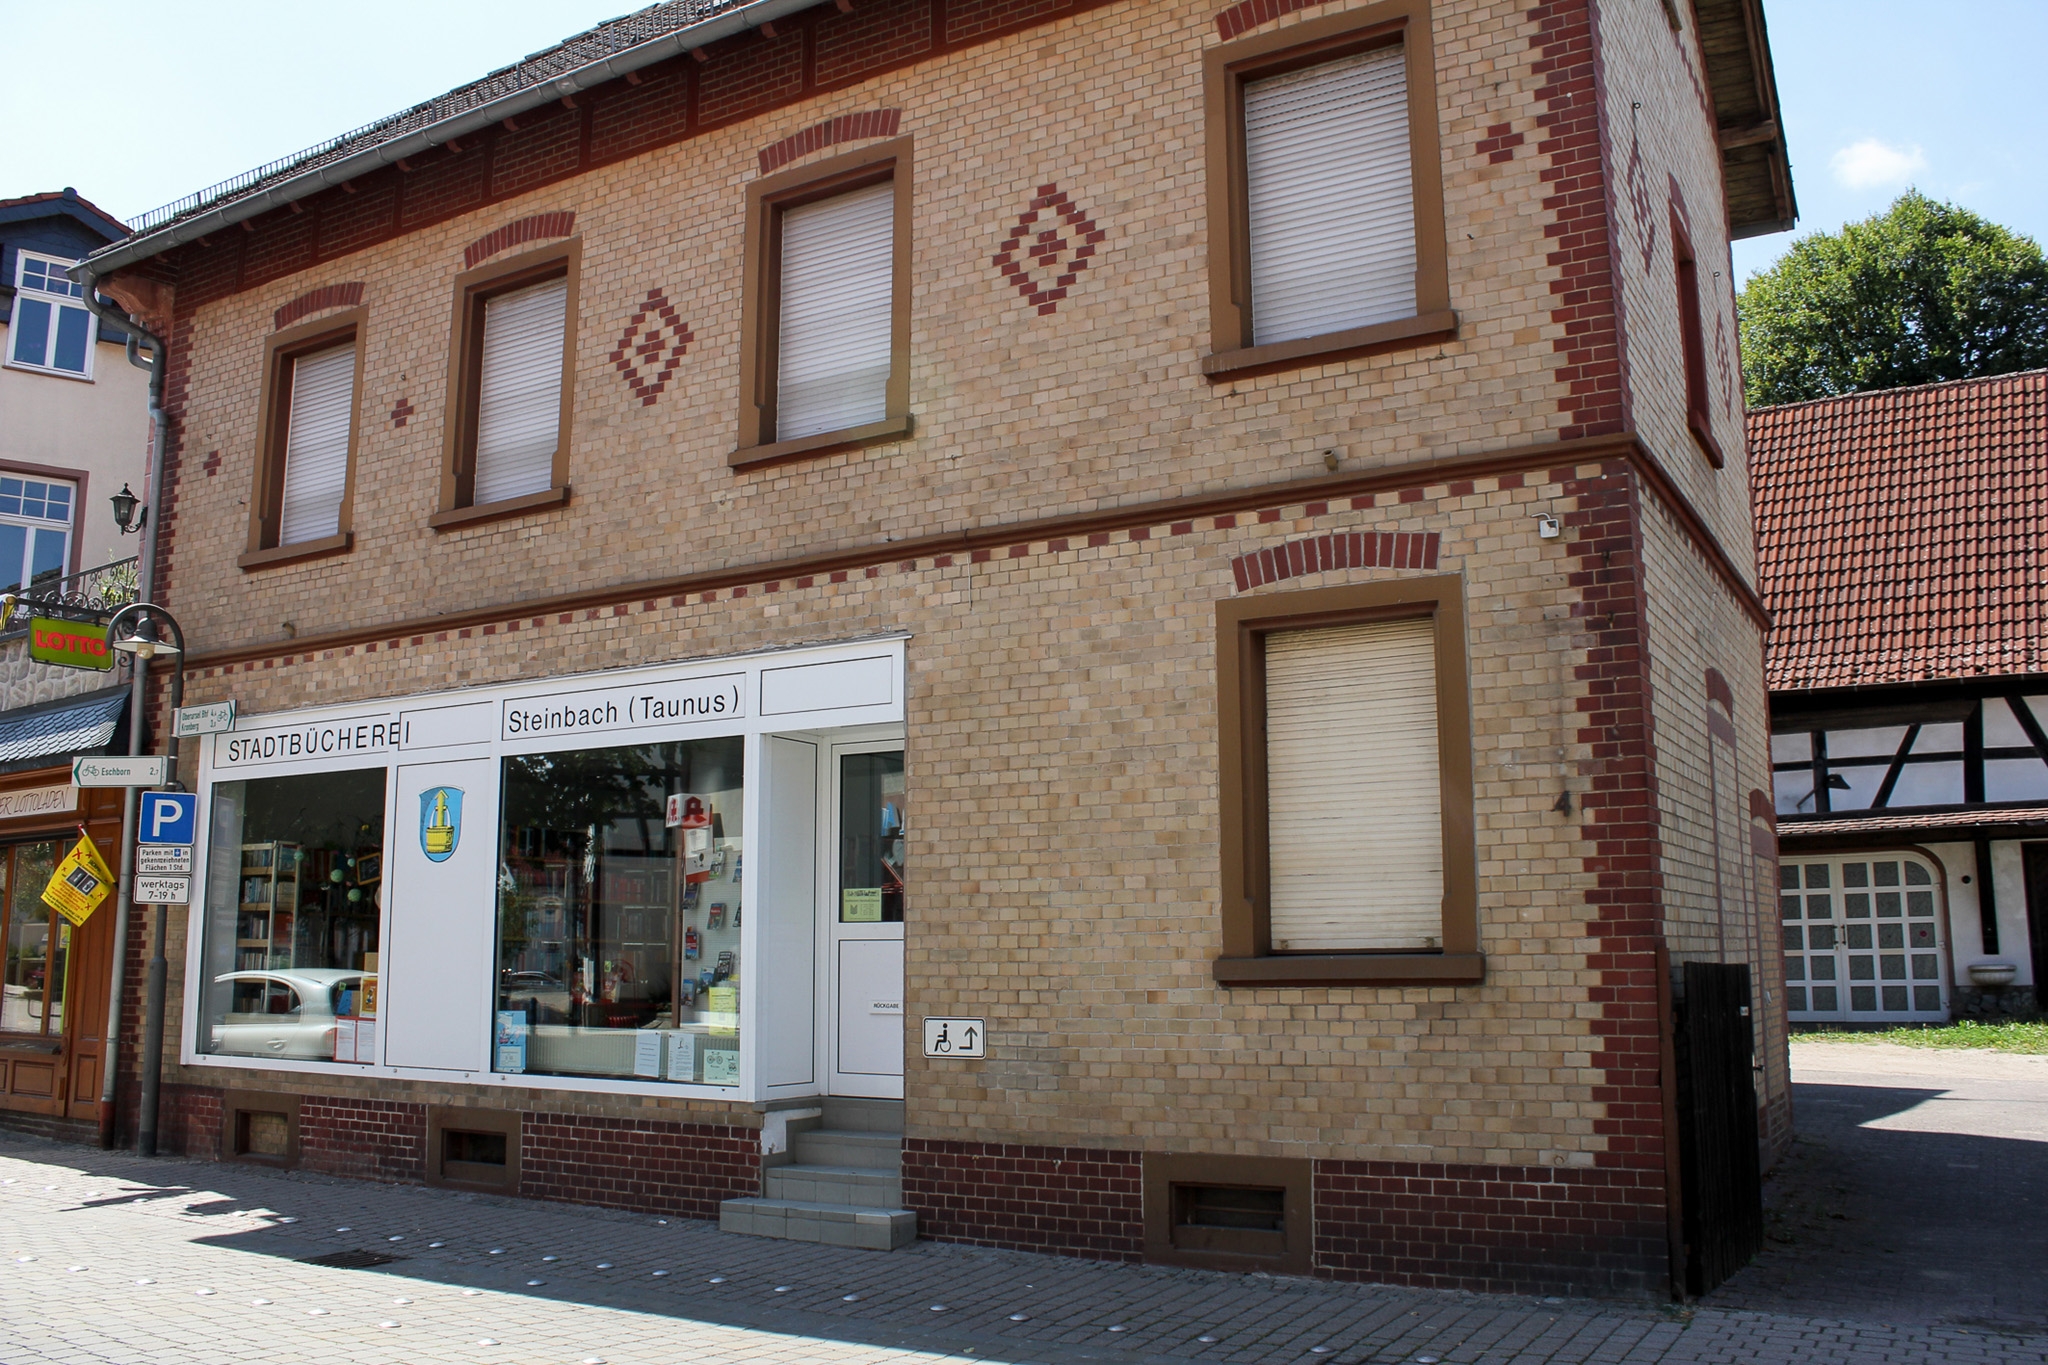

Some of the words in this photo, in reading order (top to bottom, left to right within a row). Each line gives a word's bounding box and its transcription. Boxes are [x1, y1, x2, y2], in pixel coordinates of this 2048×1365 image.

[35, 629, 107, 657] LOTTO
[508, 700, 618, 733] Steinbach
[629, 684, 739, 723] (Taunus)
[228, 721, 410, 762] STADTBÜCHEREI
[101, 767, 131, 776] Eschborn
[14, 786, 70, 813] LOTTOLADEN
[152, 799, 183, 837] P
[140, 857, 190, 865] gekennzeichneten
[141, 880, 185, 891] werktags
[148, 891, 168, 900] 7-19
[171, 892, 176, 900] h
